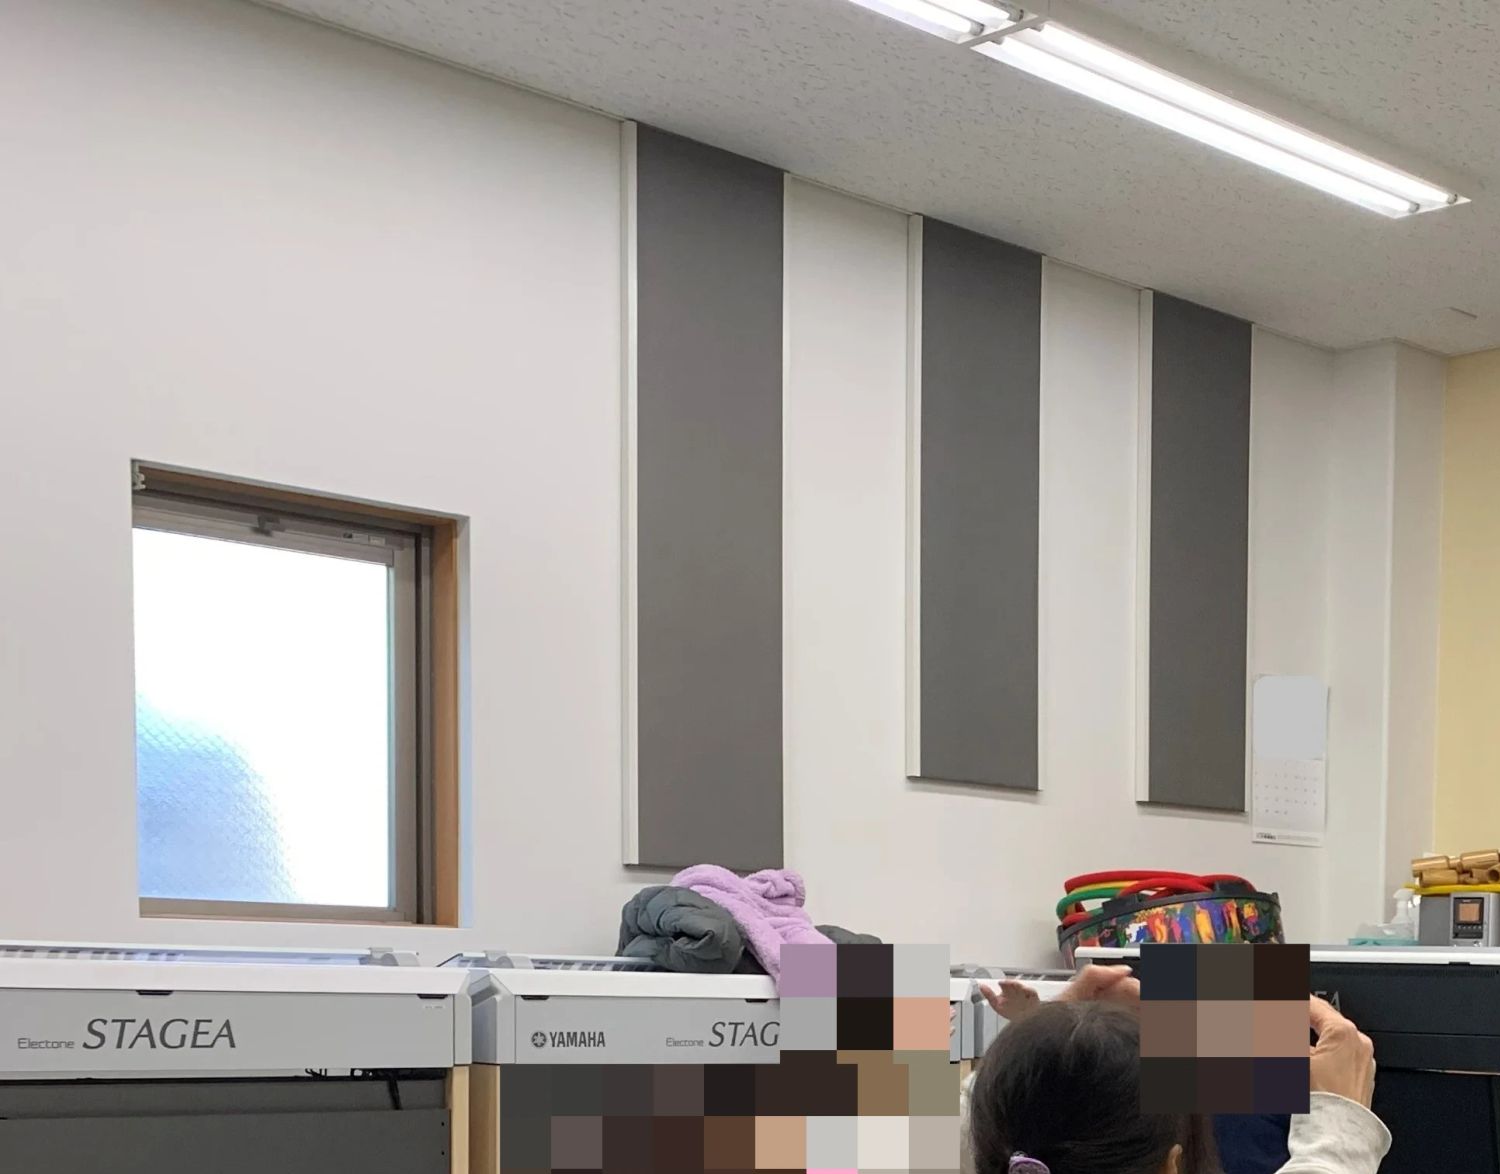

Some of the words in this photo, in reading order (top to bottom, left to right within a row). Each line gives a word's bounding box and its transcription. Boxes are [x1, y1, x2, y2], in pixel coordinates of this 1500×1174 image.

[18, 1038, 75, 1050] Electone
[82, 1018, 236, 1049] STAGEA
[550, 1031, 606, 1048] YAMAHA
